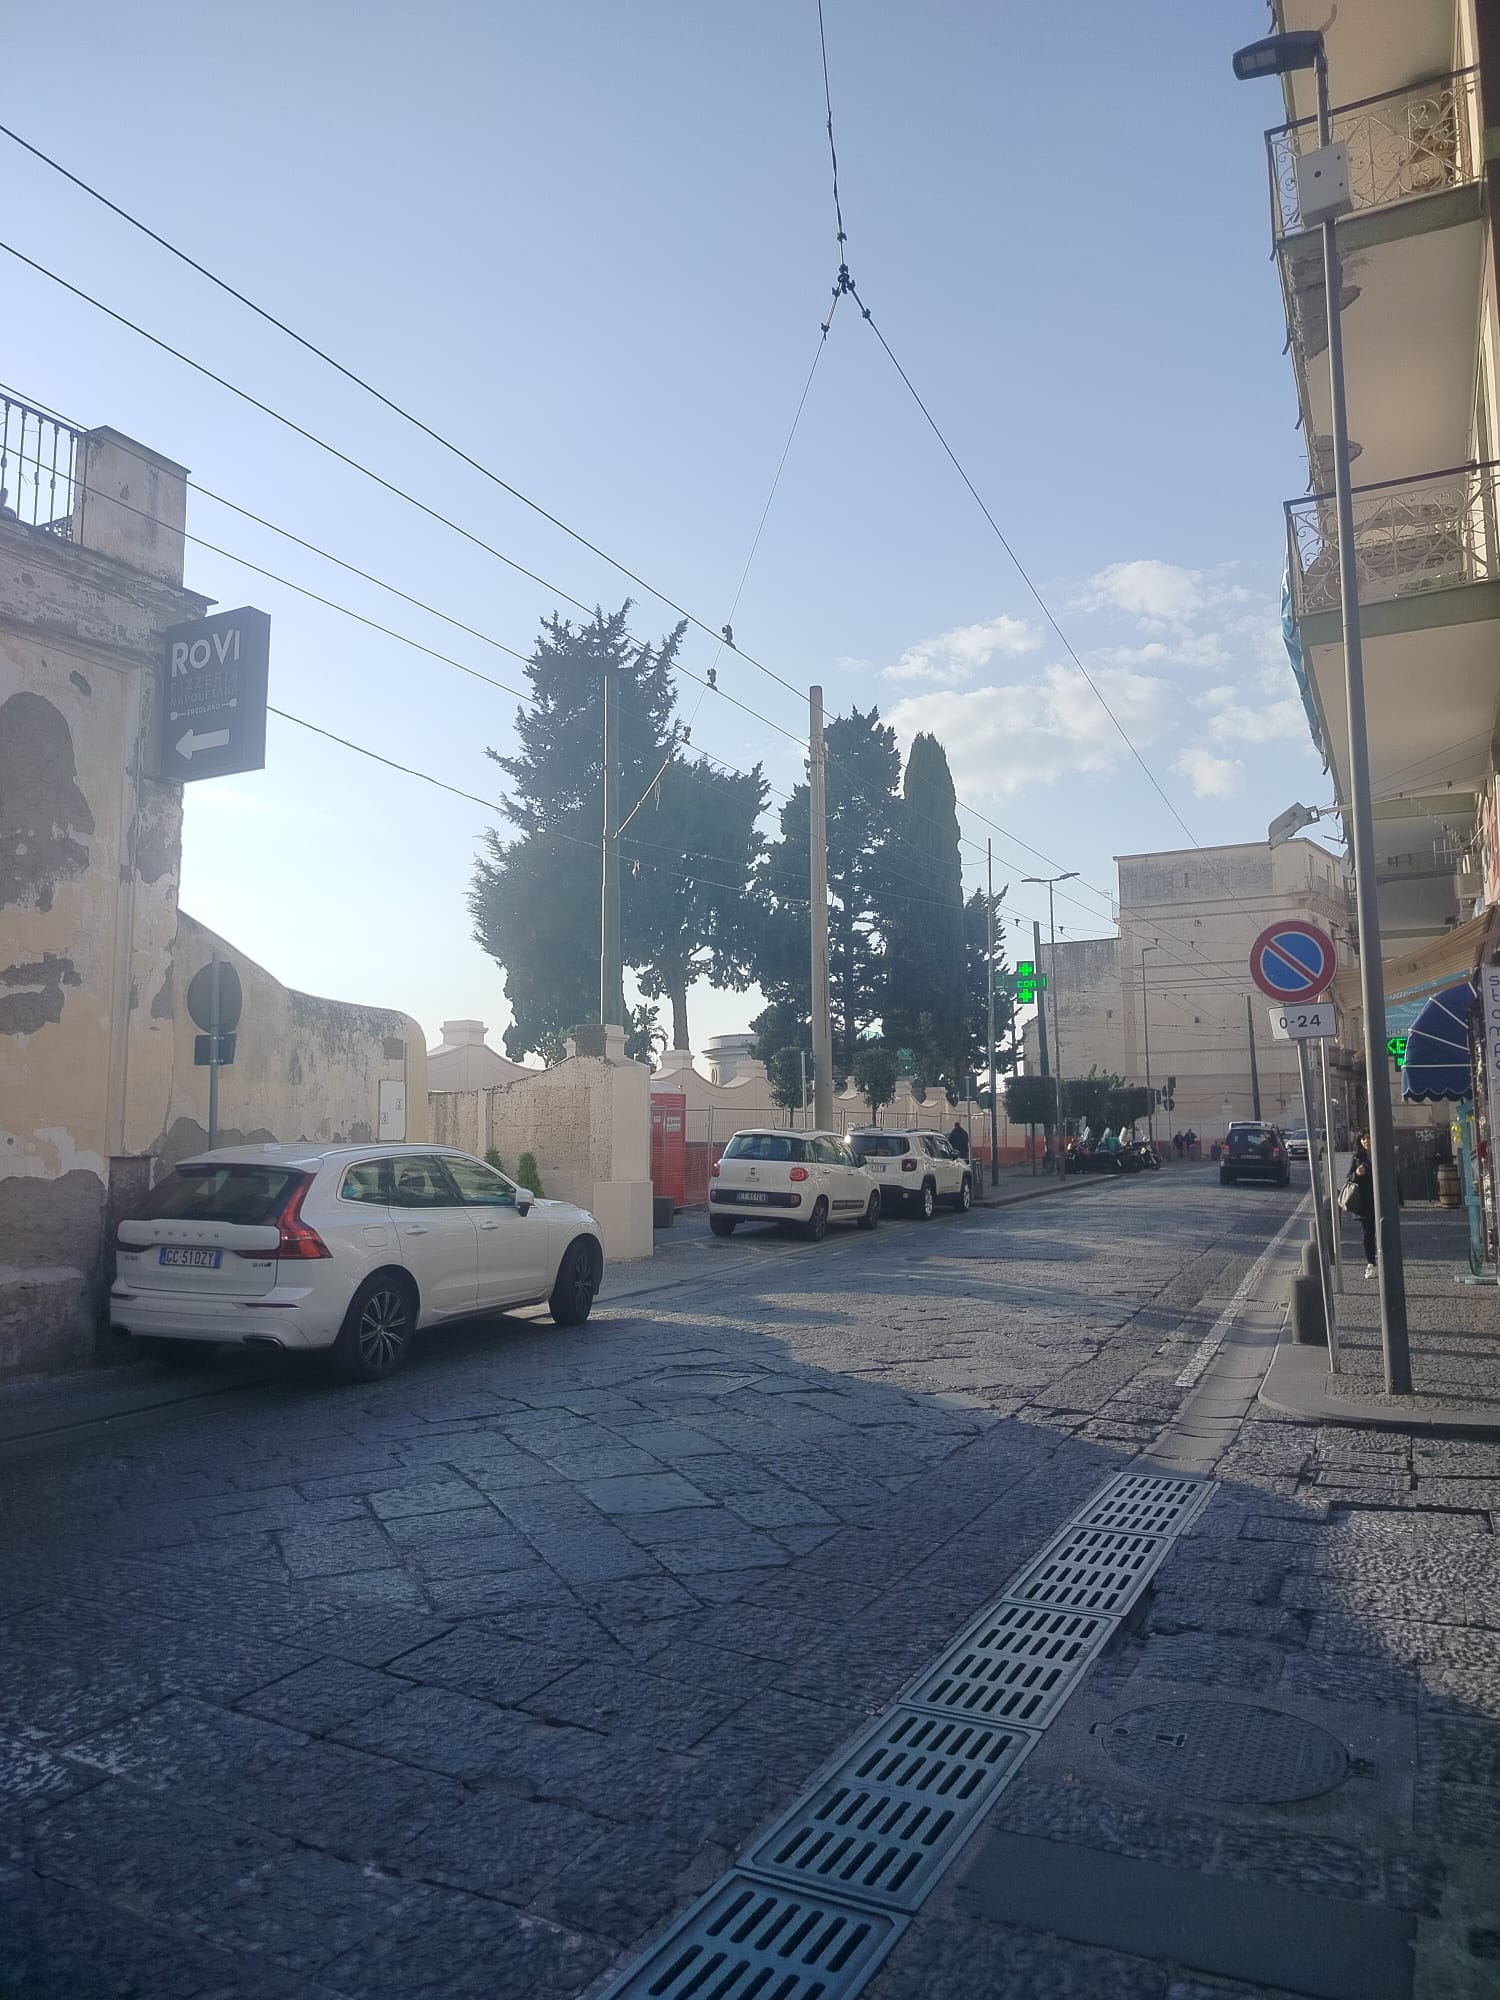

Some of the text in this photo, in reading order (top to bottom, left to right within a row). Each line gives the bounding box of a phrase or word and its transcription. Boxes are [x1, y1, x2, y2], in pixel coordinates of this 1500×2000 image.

[171, 629, 241, 678] ROVI
[170, 668, 239, 693] PIZZERIA
[1279, 1014, 1321, 1029] 0-24
